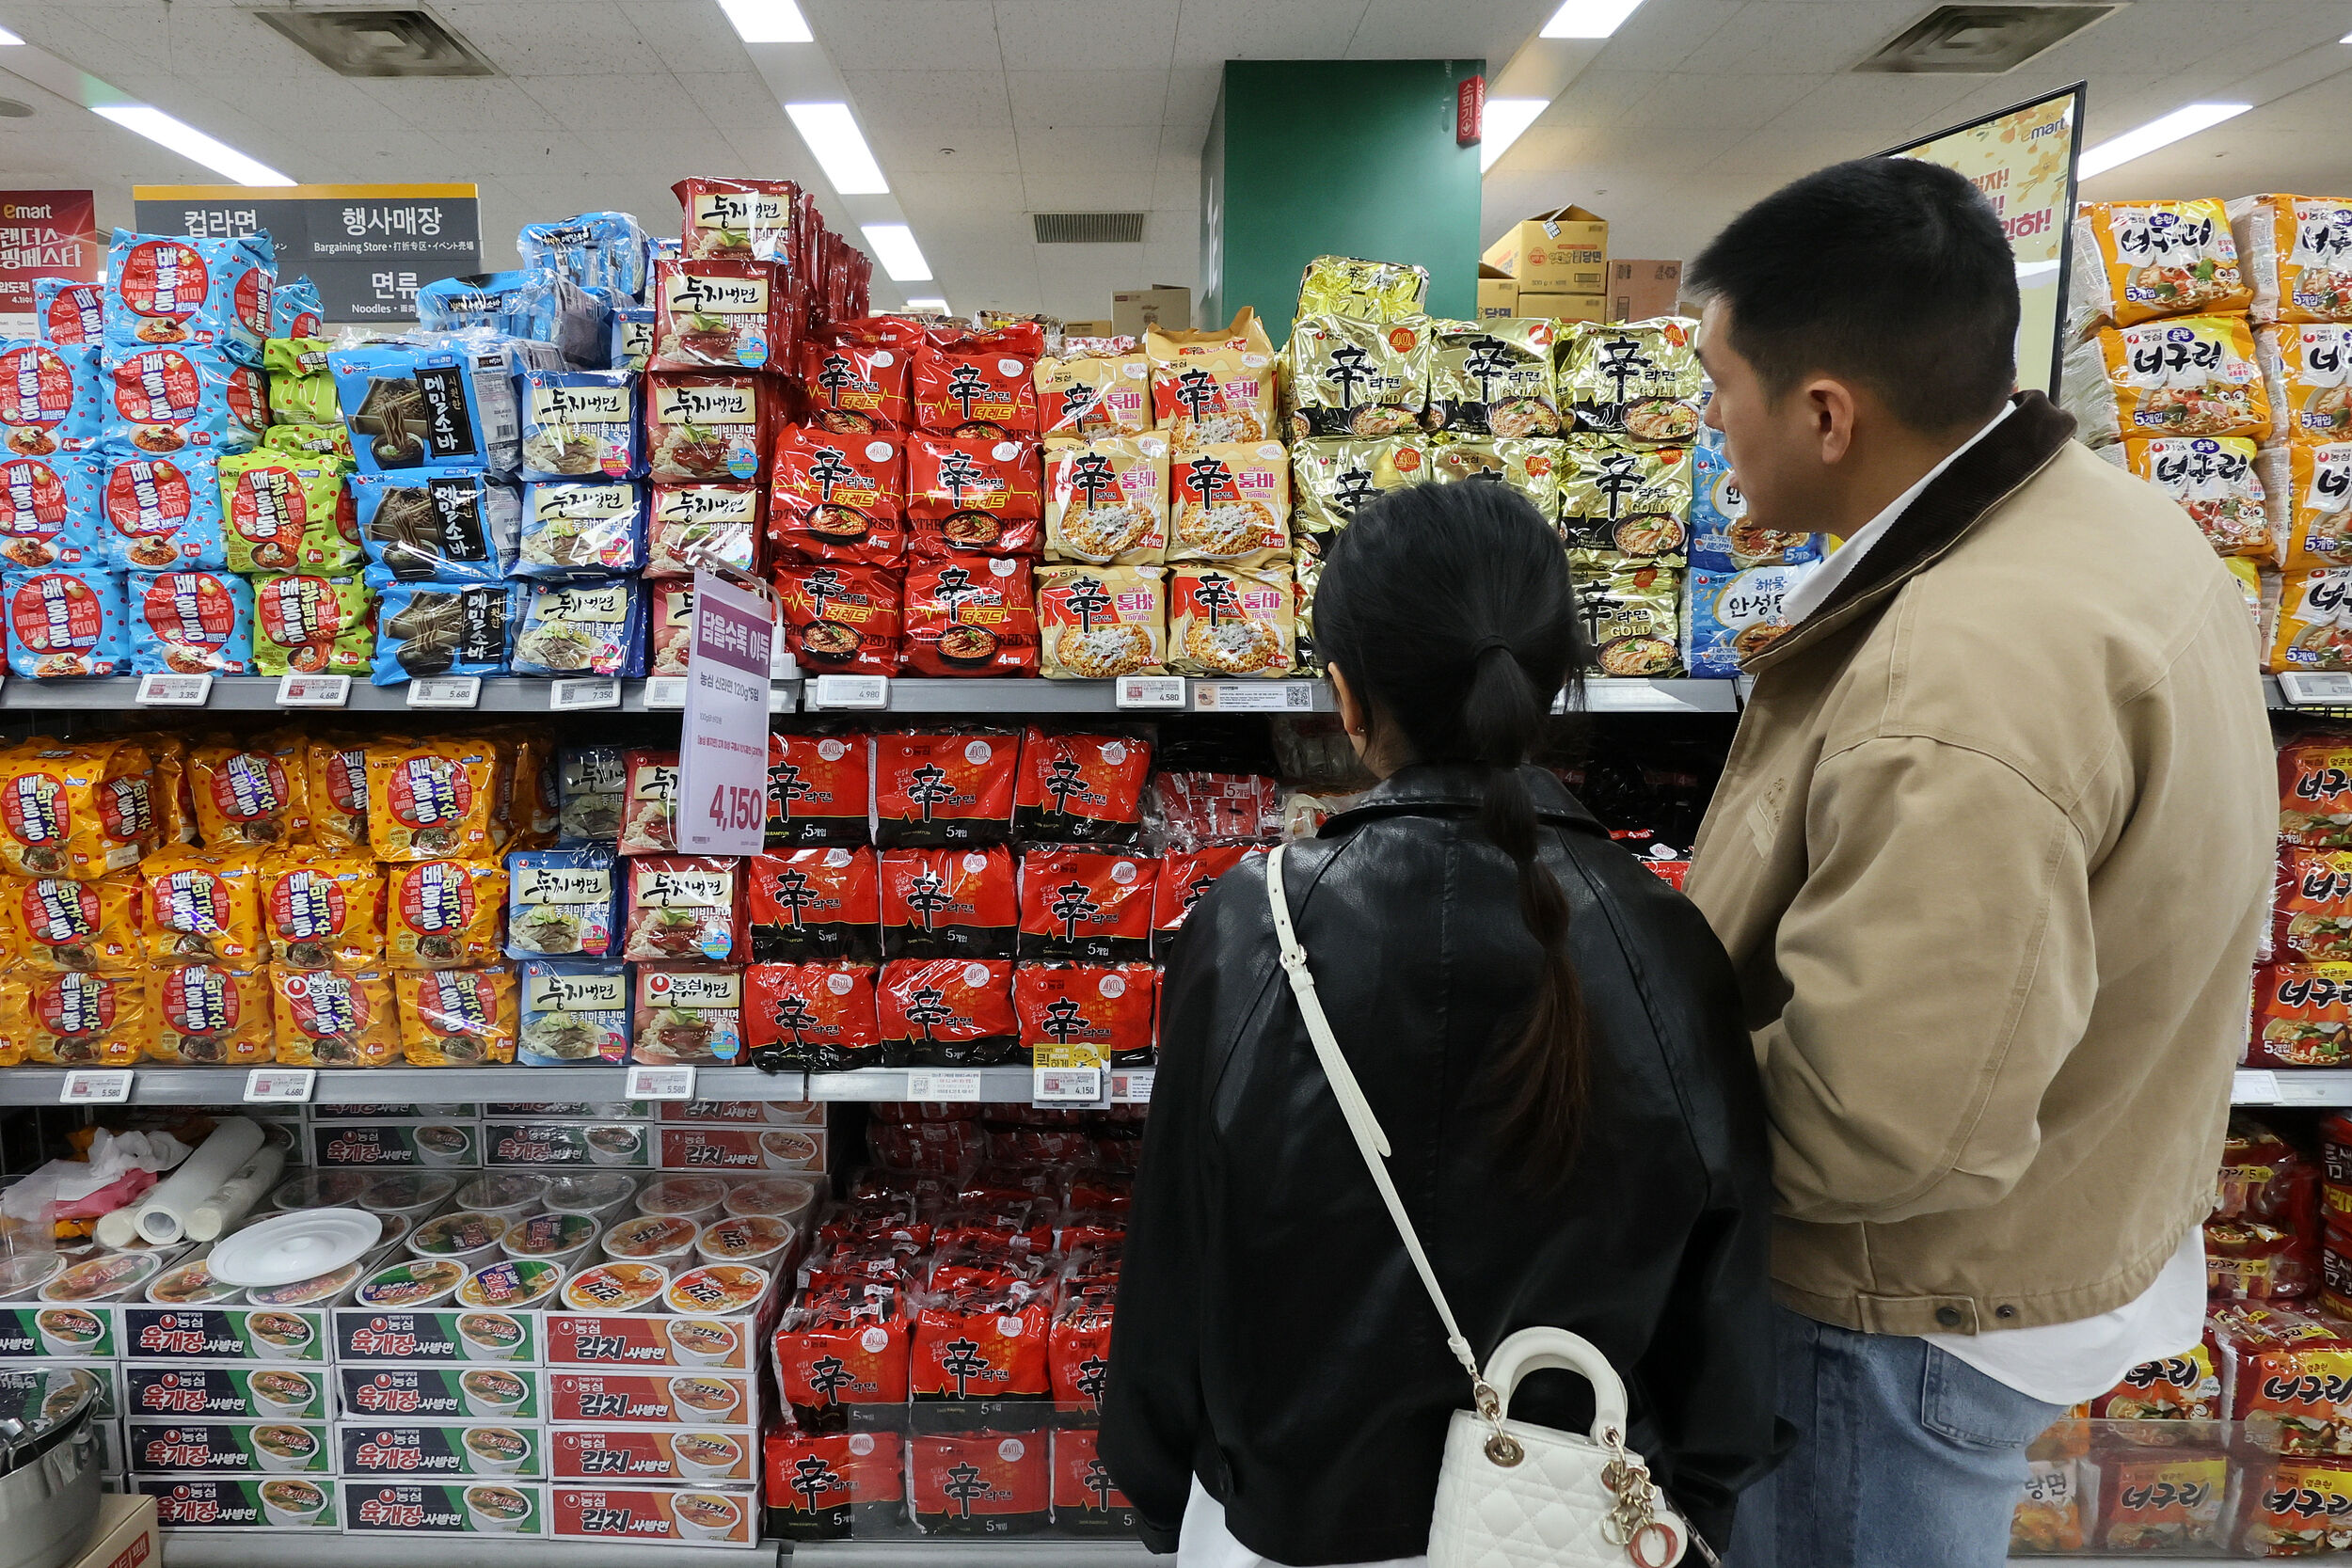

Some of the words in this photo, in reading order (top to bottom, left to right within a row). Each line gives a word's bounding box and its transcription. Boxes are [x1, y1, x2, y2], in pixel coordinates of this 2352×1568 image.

[4, 203, 53, 219] emart
[184, 209, 257, 237] 컵라면
[342, 206, 443, 236] 행사매장
[2122, 217, 2214, 254] 너구리
[0, 245, 83, 270] 핑페스타
[314, 242, 362, 255] Bargaining
[372, 272, 421, 300] 면류
[673, 276, 759, 312] 둥지냉면
[2125, 288, 2157, 302] 5개입
[352, 304, 391, 313] Noodles
[723, 314, 768, 329] 비빔냉면
[2134, 341, 2222, 374] 너구리
[1326, 346, 1378, 410] 辛
[1369, 375, 1401, 390] 라면
[1598, 339, 1654, 405] 辛
[1644, 369, 1677, 384] 라면
[19, 352, 40, 421] 배홍동
[141, 353, 173, 420] 배홍동
[948, 364, 991, 420] 辛
[983, 391, 1011, 404] 라면
[1225, 382, 1261, 400] 툼바
[1362, 391, 1401, 404] GOLD
[173, 407, 197, 420] 비빔면
[424, 374, 459, 451] 메밀소바
[539, 388, 622, 425] 둥지냉면
[664, 387, 747, 424] 둥지냉면
[972, 406, 1015, 420] 더레드
[571, 422, 631, 438] 동치미물냉면
[2134, 412, 2164, 426] 5개입
[711, 423, 756, 440] 비빔냉면
[809, 445, 853, 501] 辛
[846, 477, 876, 489] 라면
[1237, 471, 1277, 489] 툼바
[2157, 453, 2248, 485] 너구리
[1187, 455, 1232, 514] 辛
[1212, 490, 1234, 499] 라면
[1244, 491, 1272, 499] Toomba
[248, 471, 278, 536] 배홍동
[833, 492, 878, 508] 더레드
[867, 534, 890, 549] 4개입
[1262, 533, 1285, 547] 4개입
[2305, 537, 2336, 551] 5개입
[1059, 568, 1078, 578] 농심
[1756, 577, 1787, 593] 해물
[935, 564, 979, 624] 辛
[973, 594, 1002, 607] 라면
[1066, 576, 1112, 635] 辛
[1092, 614, 1113, 623] 라면
[1117, 594, 1154, 611] 툼바
[40, 578, 72, 649] 배홍동
[173, 575, 206, 642] 배홍동
[278, 578, 306, 645] 배홍동
[961, 610, 1005, 625] 더레드
[1576, 579, 1625, 647] 辛
[1617, 610, 1649, 623] 라면
[205, 631, 229, 643] 비빔면
[466, 594, 487, 660] 메밀소바
[565, 622, 625, 638] 동치미물냉면
[702, 610, 748, 657] 담을수록
[750, 630, 770, 664] 이득
[1610, 626, 1652, 638] GOLD
[72, 635, 98, 648] 비빔면
[700, 671, 715, 688] 농심
[715, 674, 733, 693] 신라면
[408, 758, 438, 824] 배홍동
[908, 763, 955, 823] 辛
[947, 795, 977, 807] 라면
[18, 775, 45, 842] 배홍동
[709, 784, 763, 832] 4,150
[946, 825, 968, 838] 5개입
[525, 868, 603, 905] 둥지냉면
[553, 903, 610, 919] 동치미물냉면
[1052, 880, 1100, 943] 辛
[1091, 913, 1120, 925] 라면
[1088, 942, 1109, 957] 5개입
[309, 981, 340, 995] 농심
[537, 975, 618, 1011] 둥지냉면
[673, 978, 703, 992] 농심
[184, 966, 207, 1031] 배홍동
[204, 980, 227, 1031] 막국수
[569, 1010, 627, 1025] 동치미물냉면
[697, 1009, 740, 1024] 비빔냉면
[2264, 1039, 2295, 1054] 5개입
[327, 1143, 379, 1163] 육개장
[685, 1146, 724, 1165] 김치
[723, 1154, 758, 1165] 사발면
[179, 1315, 203, 1328] 농심
[574, 1323, 601, 1335] 농심
[140, 1326, 205, 1354] 육개장
[204, 1338, 244, 1354] 사발면
[574, 1336, 625, 1360] 김치
[624, 1346, 665, 1361] 사발면
[180, 1373, 206, 1387] 농심
[943, 1338, 990, 1400] 辛
[981, 1370, 1010, 1381] 라면
[142, 1384, 207, 1412] 육개장
[206, 1396, 246, 1411] 사발면
[580, 1437, 606, 1449] 농심
[580, 1450, 629, 1474] 김치
[628, 1460, 670, 1474] 사발면
[396, 1490, 422, 1503] 농심
[944, 1462, 991, 1518] 辛
[984, 1490, 1013, 1501] 라면
[2122, 1482, 2211, 1510] 너구리
[359, 1500, 423, 1526] 육개장
[421, 1513, 461, 1526] 사발면
[986, 1520, 1009, 1532] 5개입
